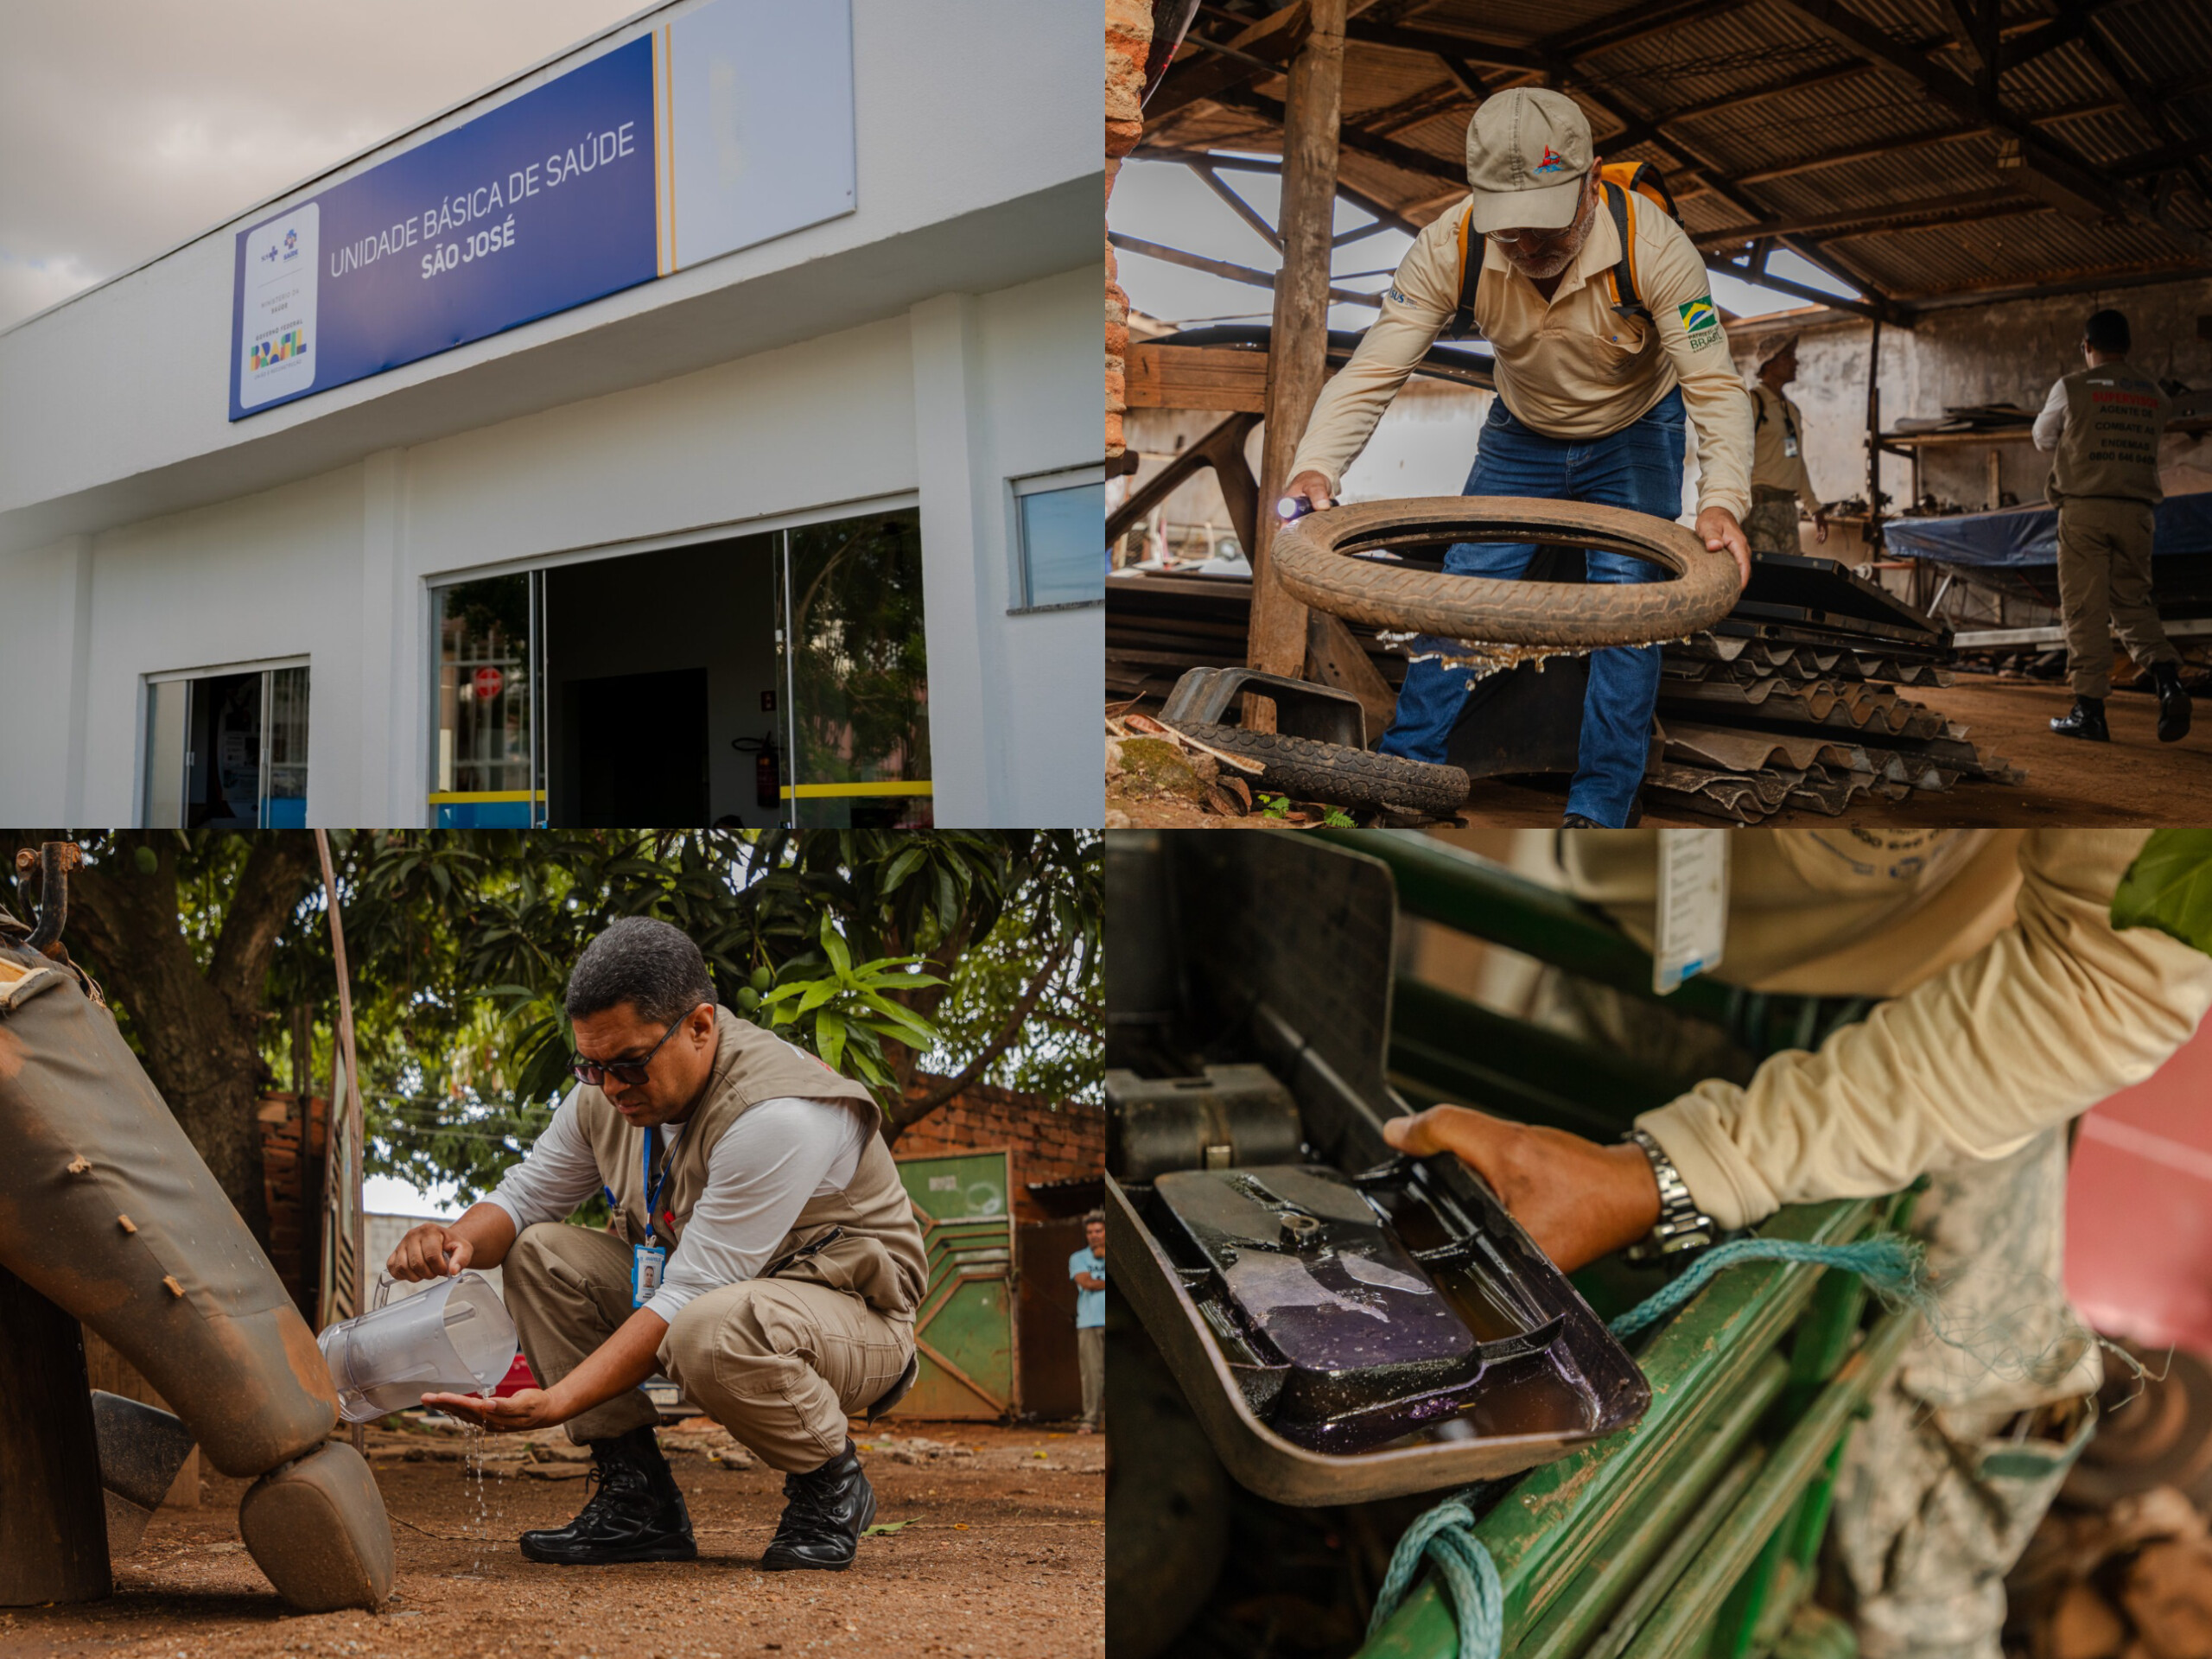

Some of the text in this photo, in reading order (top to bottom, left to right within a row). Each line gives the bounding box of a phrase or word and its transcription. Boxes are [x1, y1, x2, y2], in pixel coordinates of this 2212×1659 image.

[331, 121, 635, 278] UNIDADE BÁSICA DE SAÚDE
[421, 213, 516, 279] SÃO JOSÉ
[1690, 332, 1722, 349] BRASIL
[250, 327, 307, 372] BRASIL
[2100, 405, 2153, 418] AGENTE DE
[2094, 422, 2143, 433] COMBATE
[2101, 439, 2150, 450] ENDEMIAS
